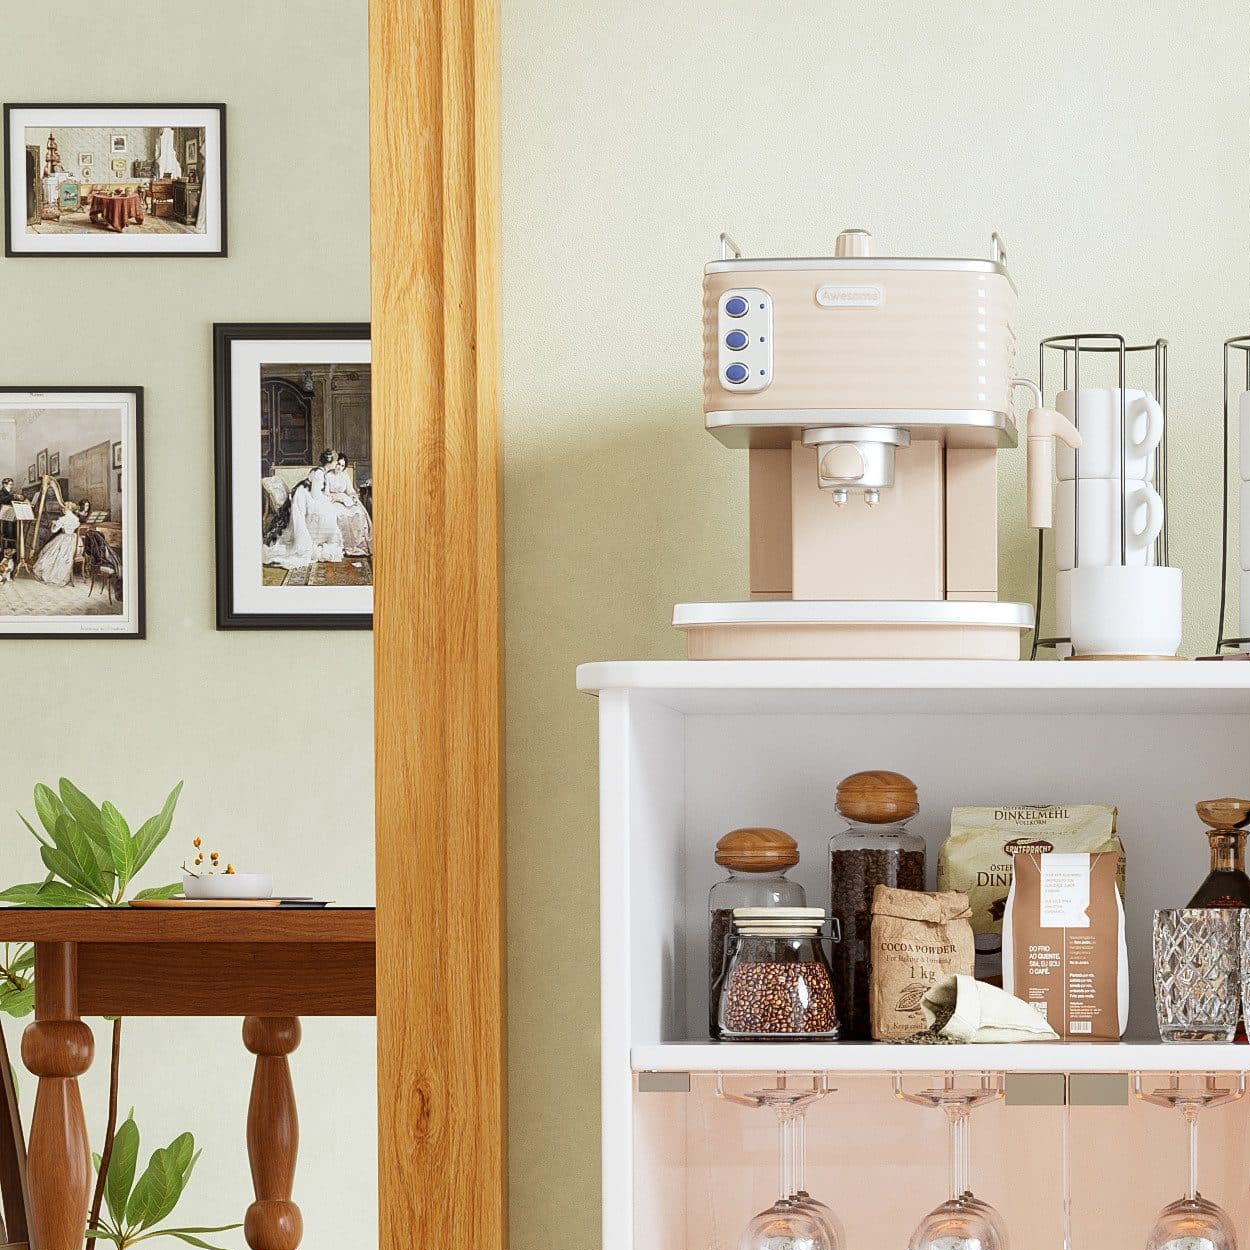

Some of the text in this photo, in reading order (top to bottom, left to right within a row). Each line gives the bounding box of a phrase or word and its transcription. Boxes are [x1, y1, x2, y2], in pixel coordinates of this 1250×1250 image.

[994, 809, 1070, 821] DINKELMEHL
[881, 942, 957, 955] COCOA POWDER
[910, 966, 936, 983] 1 kg
